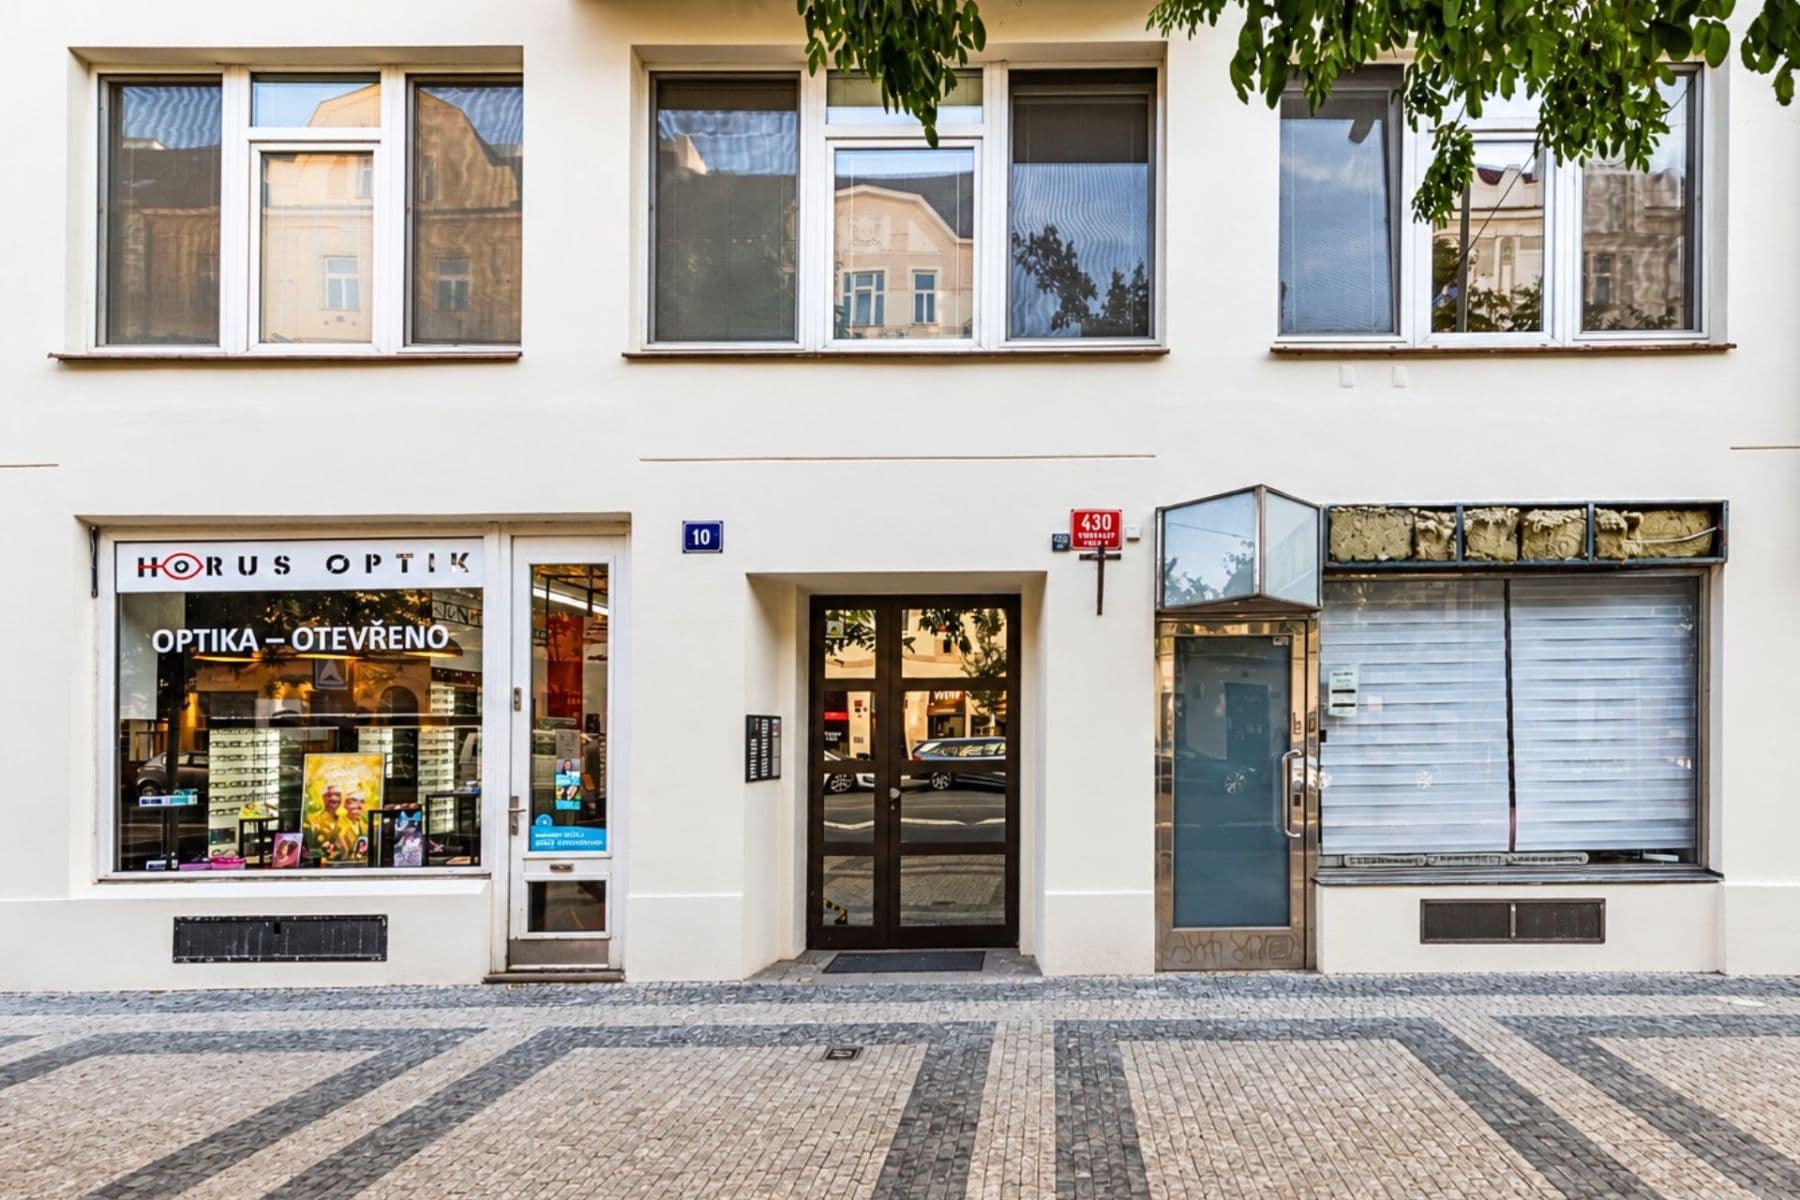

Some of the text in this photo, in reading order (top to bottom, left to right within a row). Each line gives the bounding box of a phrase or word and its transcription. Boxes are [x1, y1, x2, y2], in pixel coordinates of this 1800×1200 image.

[1081, 513, 1112, 531] 430
[692, 528, 710, 545] 10
[137, 552, 470, 580] HORUS OPTIK
[151, 627, 259, 653] OPTIKA
[291, 619, 450, 651] OTEVŘENO
